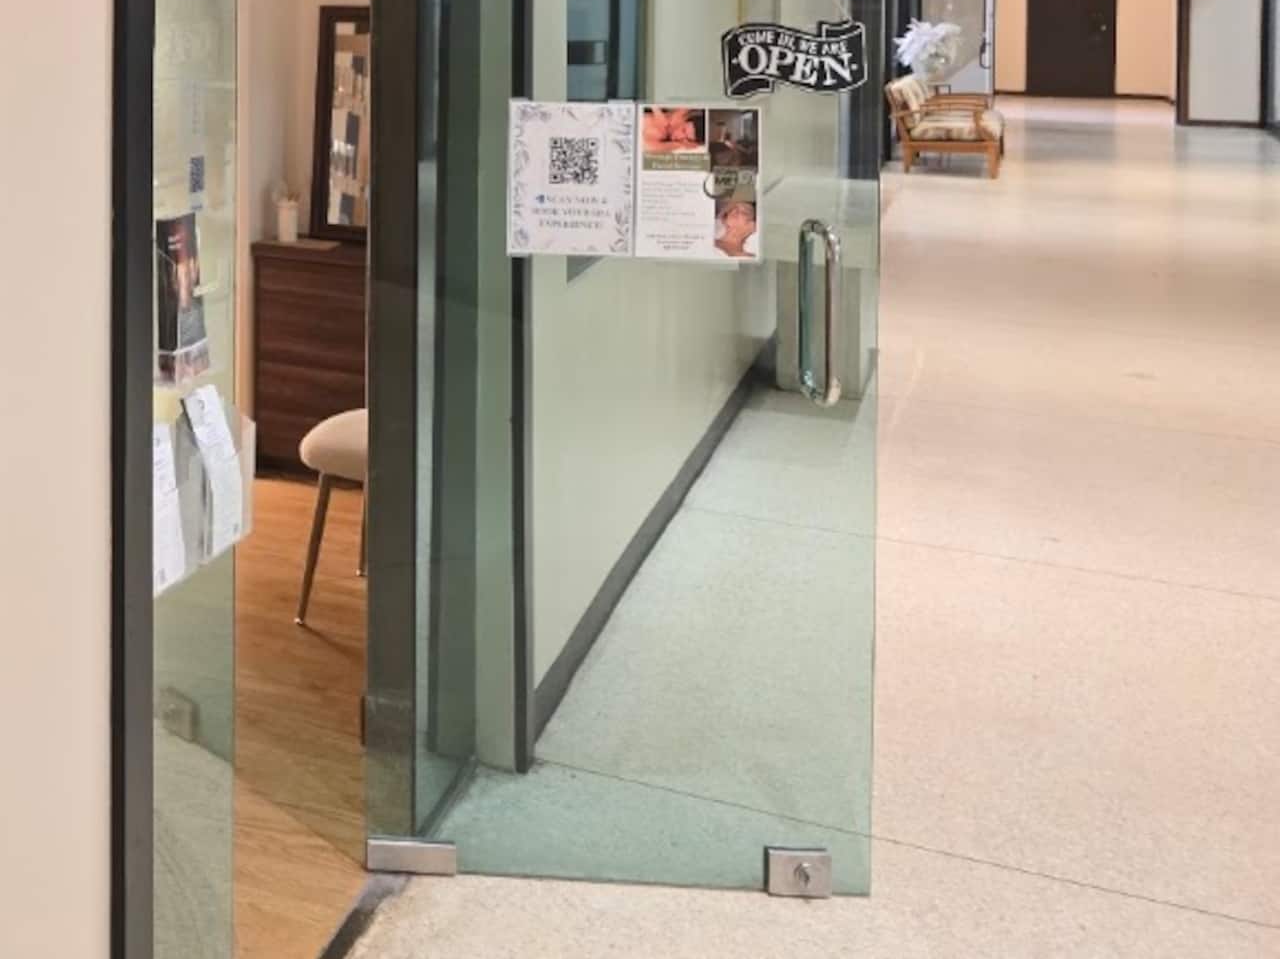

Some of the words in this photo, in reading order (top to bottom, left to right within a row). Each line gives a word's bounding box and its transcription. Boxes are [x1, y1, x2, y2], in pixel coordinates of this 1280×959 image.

[737, 31, 775, 46] COME
[799, 40, 819, 54] WE
[822, 40, 848, 55] ARE
[737, 44, 853, 86] OPEN
